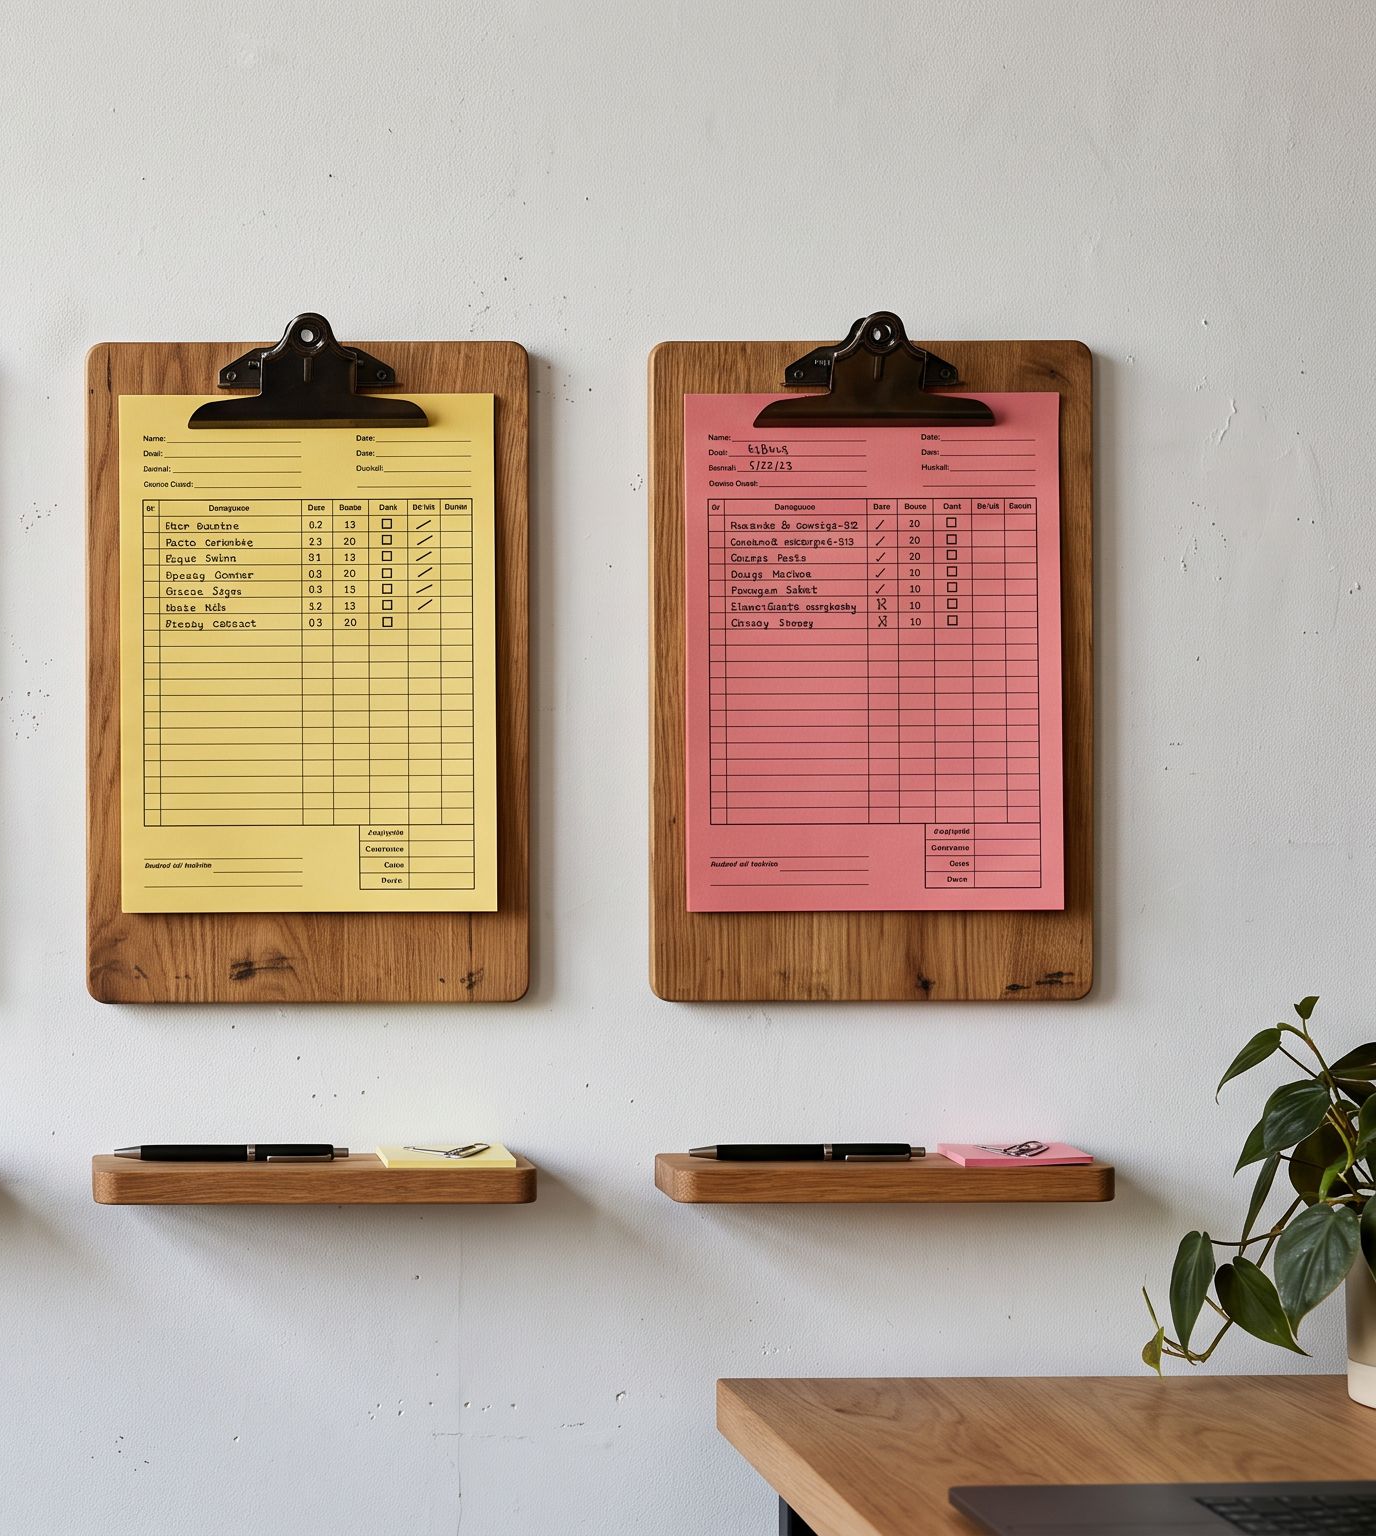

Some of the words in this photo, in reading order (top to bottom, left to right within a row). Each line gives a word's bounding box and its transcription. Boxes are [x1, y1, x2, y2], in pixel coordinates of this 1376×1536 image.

[343, 520, 356, 529] 13
[343, 537, 356, 546] 20
[343, 553, 356, 562] 13
[909, 552, 921, 561] 20
[343, 569, 356, 578] 20
[909, 584, 921, 593] 10
[343, 601, 356, 611] 13
[909, 601, 921, 610] 10
[343, 618, 356, 627] 20
[909, 617, 921, 626] 10
